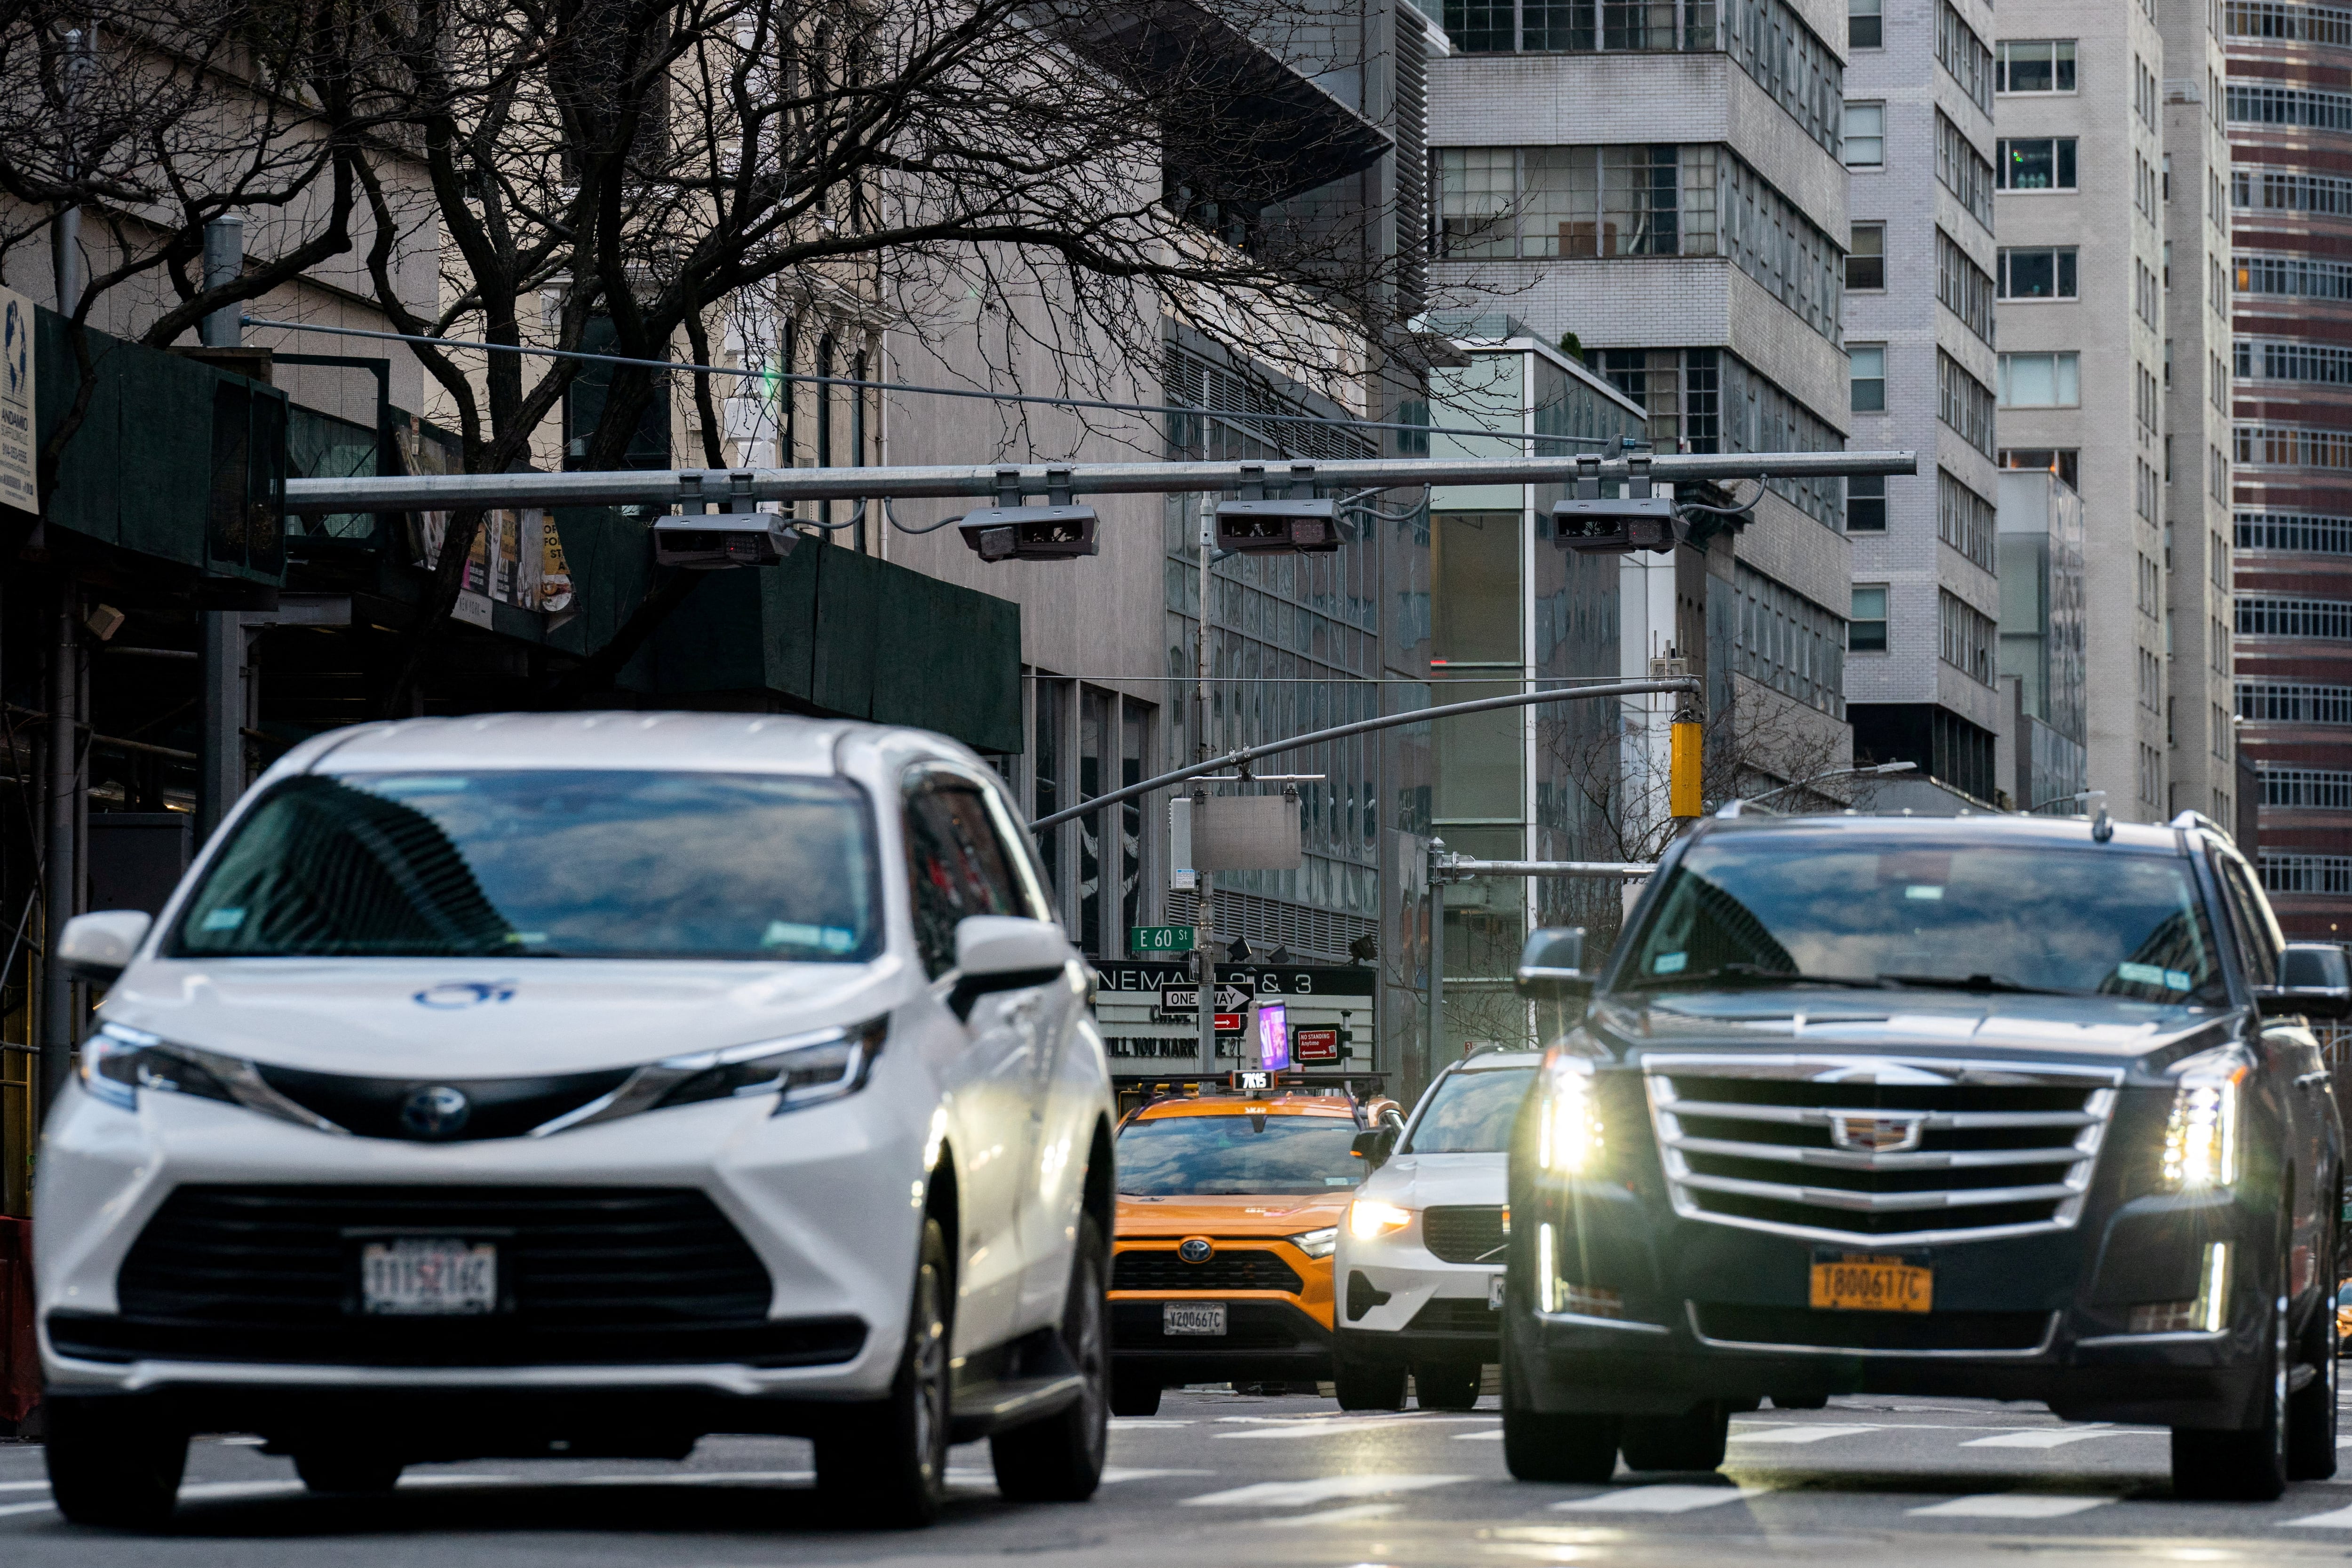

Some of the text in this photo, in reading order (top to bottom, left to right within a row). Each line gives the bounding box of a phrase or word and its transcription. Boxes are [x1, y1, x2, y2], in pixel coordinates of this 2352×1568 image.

[2, 408, 28, 431] ANDAMIO
[550, 549, 563, 558] ST
[1141, 929, 1187, 947] E 60 St
[1262, 974, 1281, 993] &
[1295, 974, 1311, 994] 3
[1171, 993, 1196, 1004] ONE
[1132, 1037, 1156, 1056] YOU
[1159, 1037, 1199, 1057] MARR
[1242, 1073, 1266, 1088] 7K15
[1170, 1312, 1220, 1327] Y200667C
